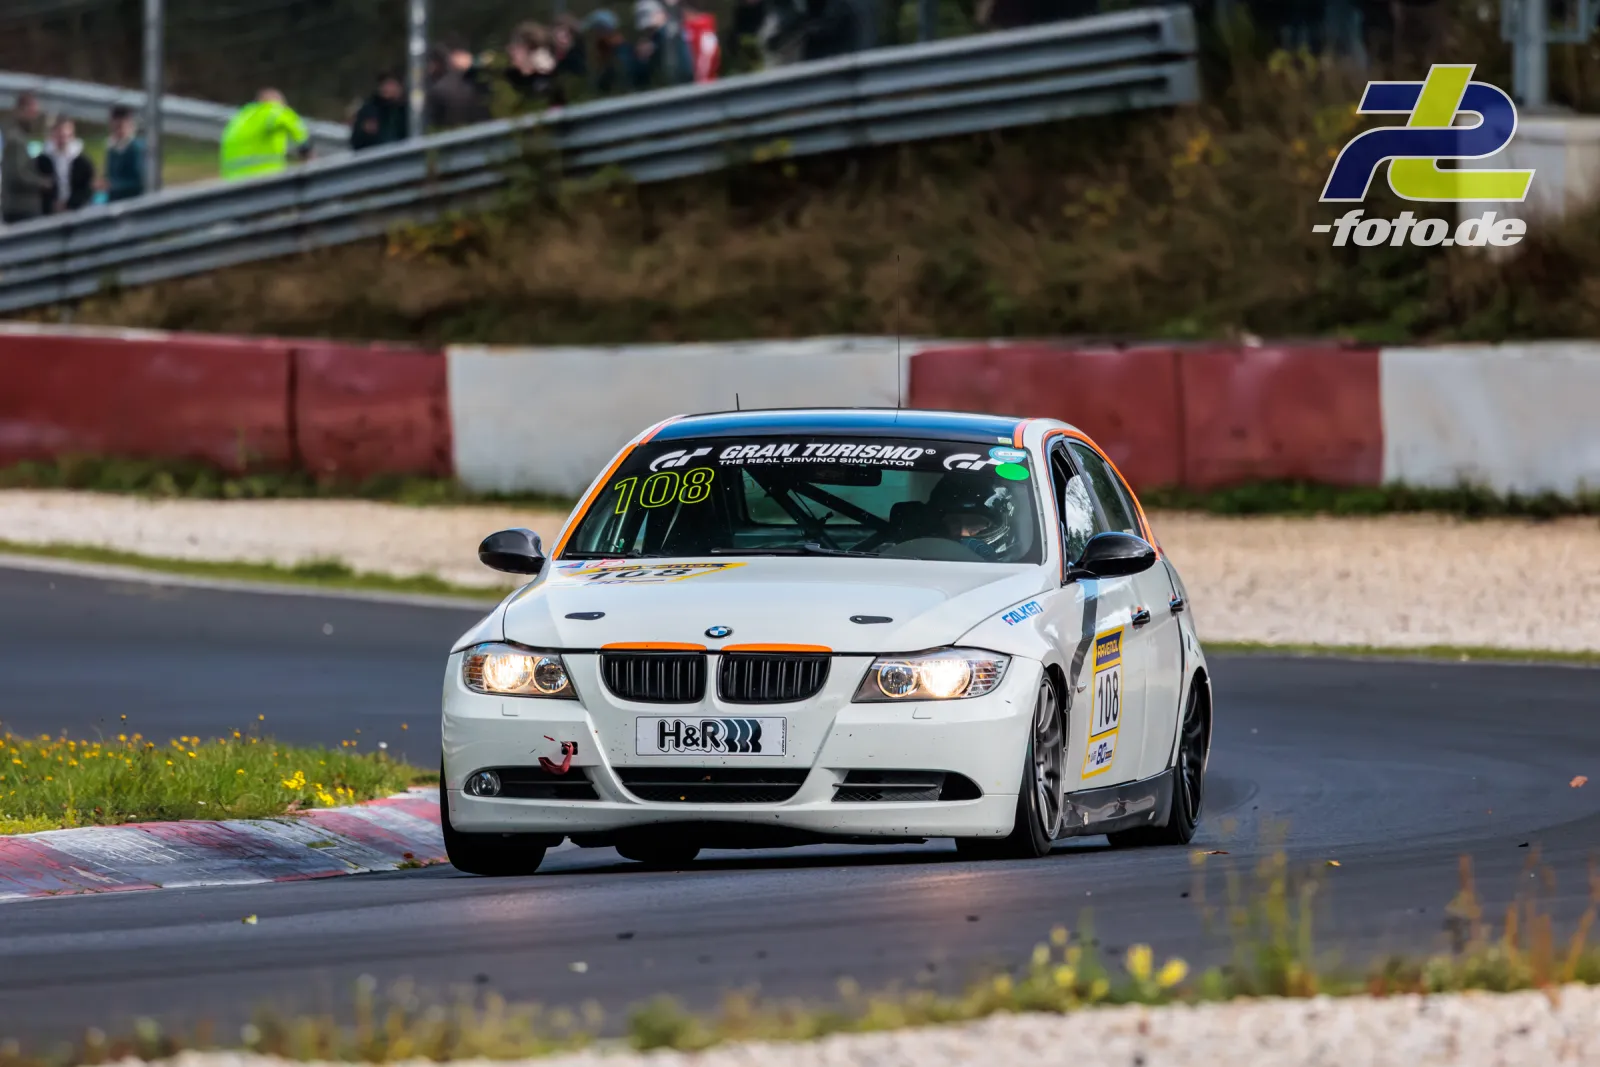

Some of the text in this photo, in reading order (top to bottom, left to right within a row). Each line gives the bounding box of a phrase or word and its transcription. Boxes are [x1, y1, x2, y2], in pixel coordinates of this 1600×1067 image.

[719, 443, 800, 460] GRAN
[719, 458, 744, 466] THE
[783, 456, 835, 464] DRIVING
[839, 457, 915, 467] SIMULATOR
[614, 467, 714, 515] 108
[588, 568, 692, 580] 108
[1001, 600, 1044, 626] FALKEN
[1097, 639, 1119, 659] RAVENOL
[1099, 670, 1119, 728] 108
[657, 719, 726, 752] H&R
